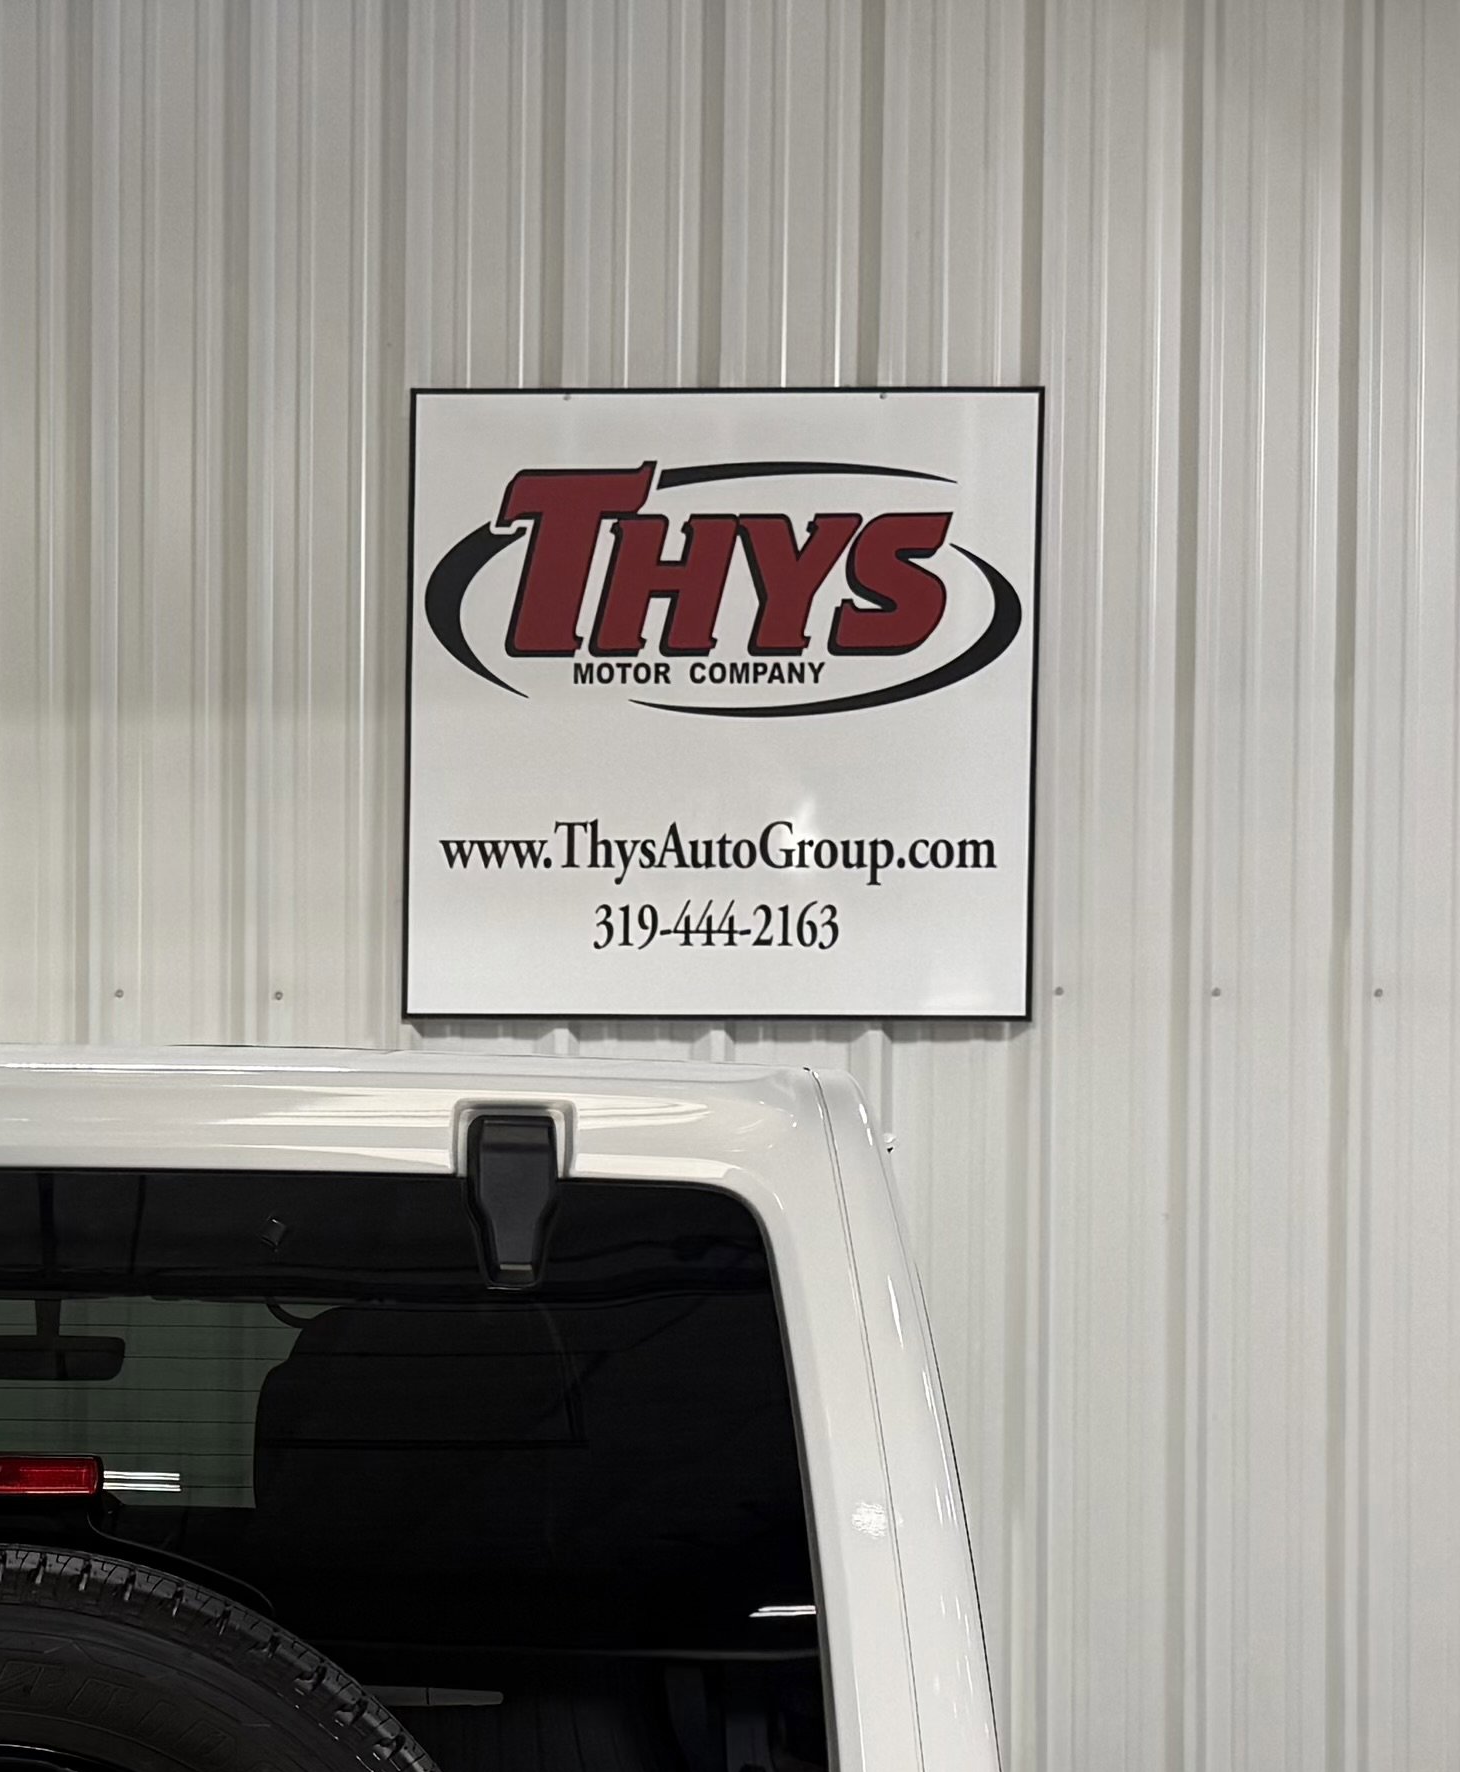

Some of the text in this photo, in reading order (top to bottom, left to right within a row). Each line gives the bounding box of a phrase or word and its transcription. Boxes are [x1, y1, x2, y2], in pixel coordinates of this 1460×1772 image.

[497, 460, 953, 657] THYS
[573, 661, 826, 685] MOTOR COMPANY
[439, 819, 997, 886] www.ThysAutoGroup.com
[593, 899, 840, 950] 319-444-2163
